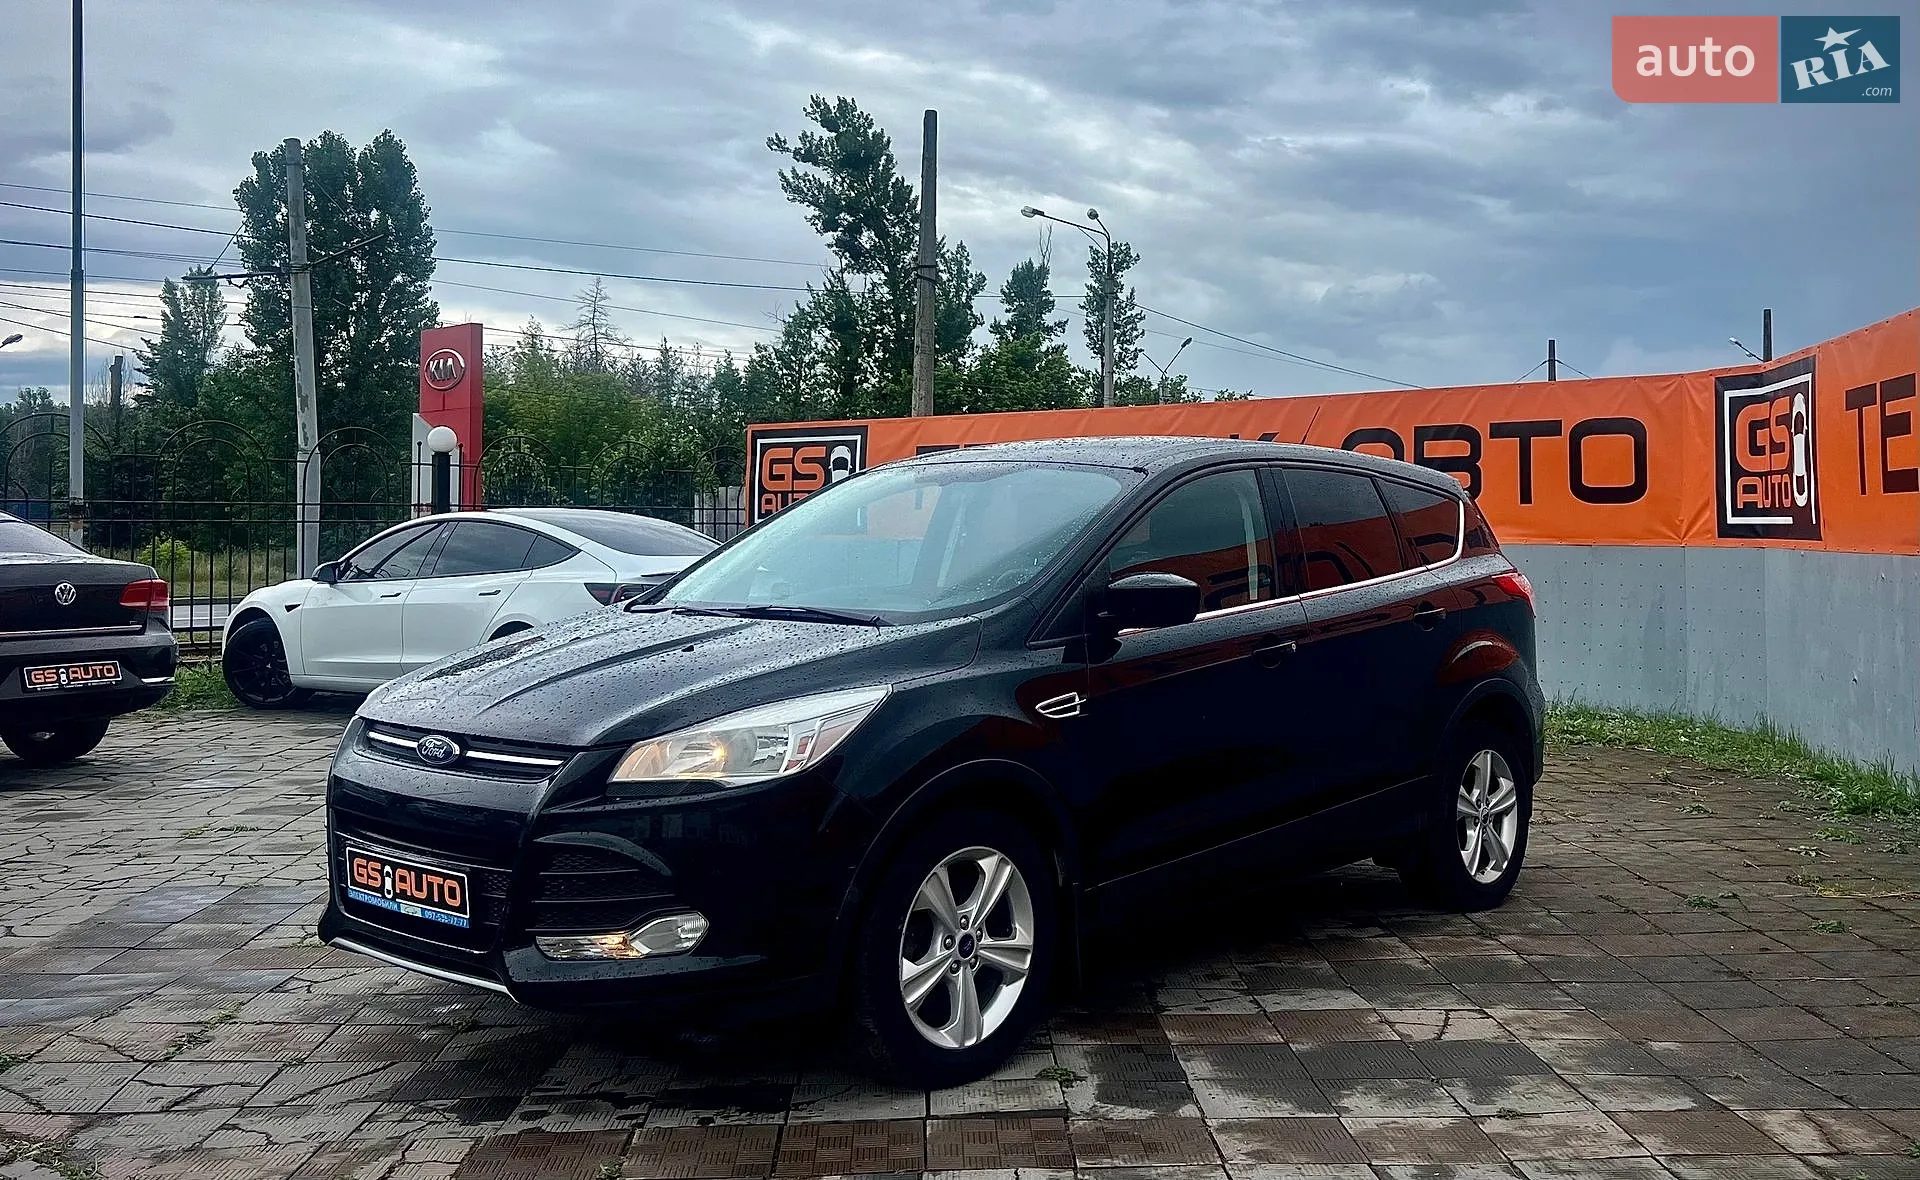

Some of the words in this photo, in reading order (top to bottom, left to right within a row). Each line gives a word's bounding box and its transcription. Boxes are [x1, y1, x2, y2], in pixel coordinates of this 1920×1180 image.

[429, 357, 457, 381] KIA
[1735, 395, 1791, 473] GS
[762, 446, 826, 491] GS
[1736, 473, 1793, 509] AUTO
[31, 669, 58, 684] GS
[68, 664, 116, 681] AUTO
[421, 738, 447, 758] Ford
[353, 857, 381, 888] GS
[395, 867, 461, 907] AUTO
